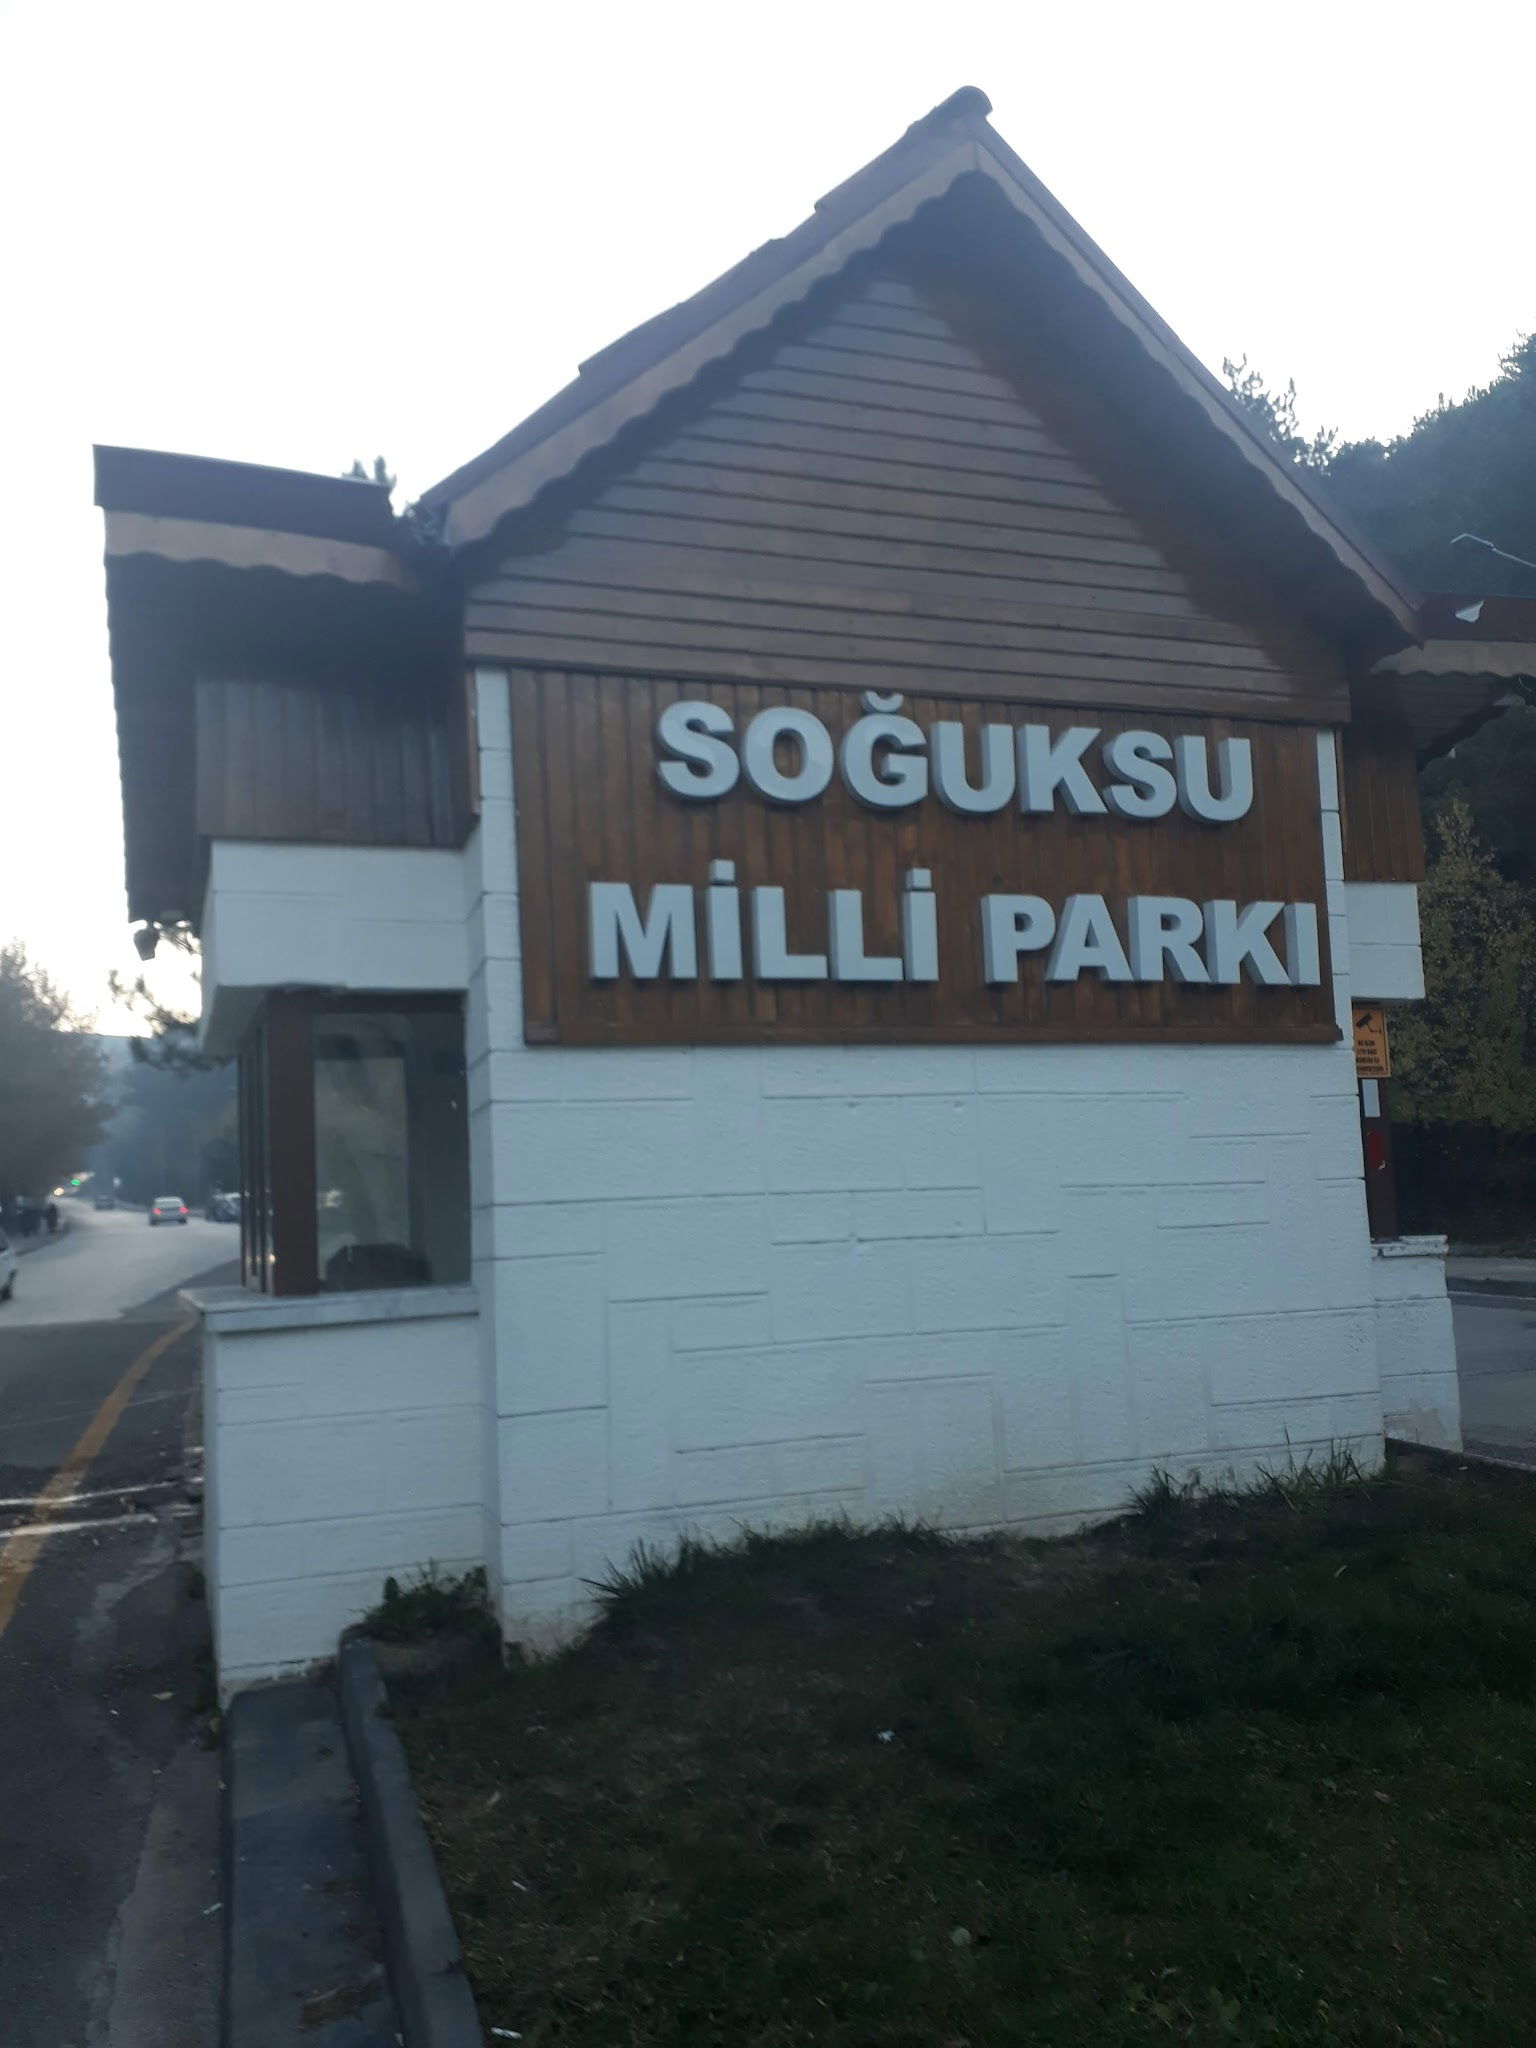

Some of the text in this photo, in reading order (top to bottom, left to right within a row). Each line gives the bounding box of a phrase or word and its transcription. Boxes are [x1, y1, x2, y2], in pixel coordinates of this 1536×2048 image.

[656, 690, 1255, 824] SOĞUKSU
[587, 858, 1322, 987] MİLLİ PARKI
